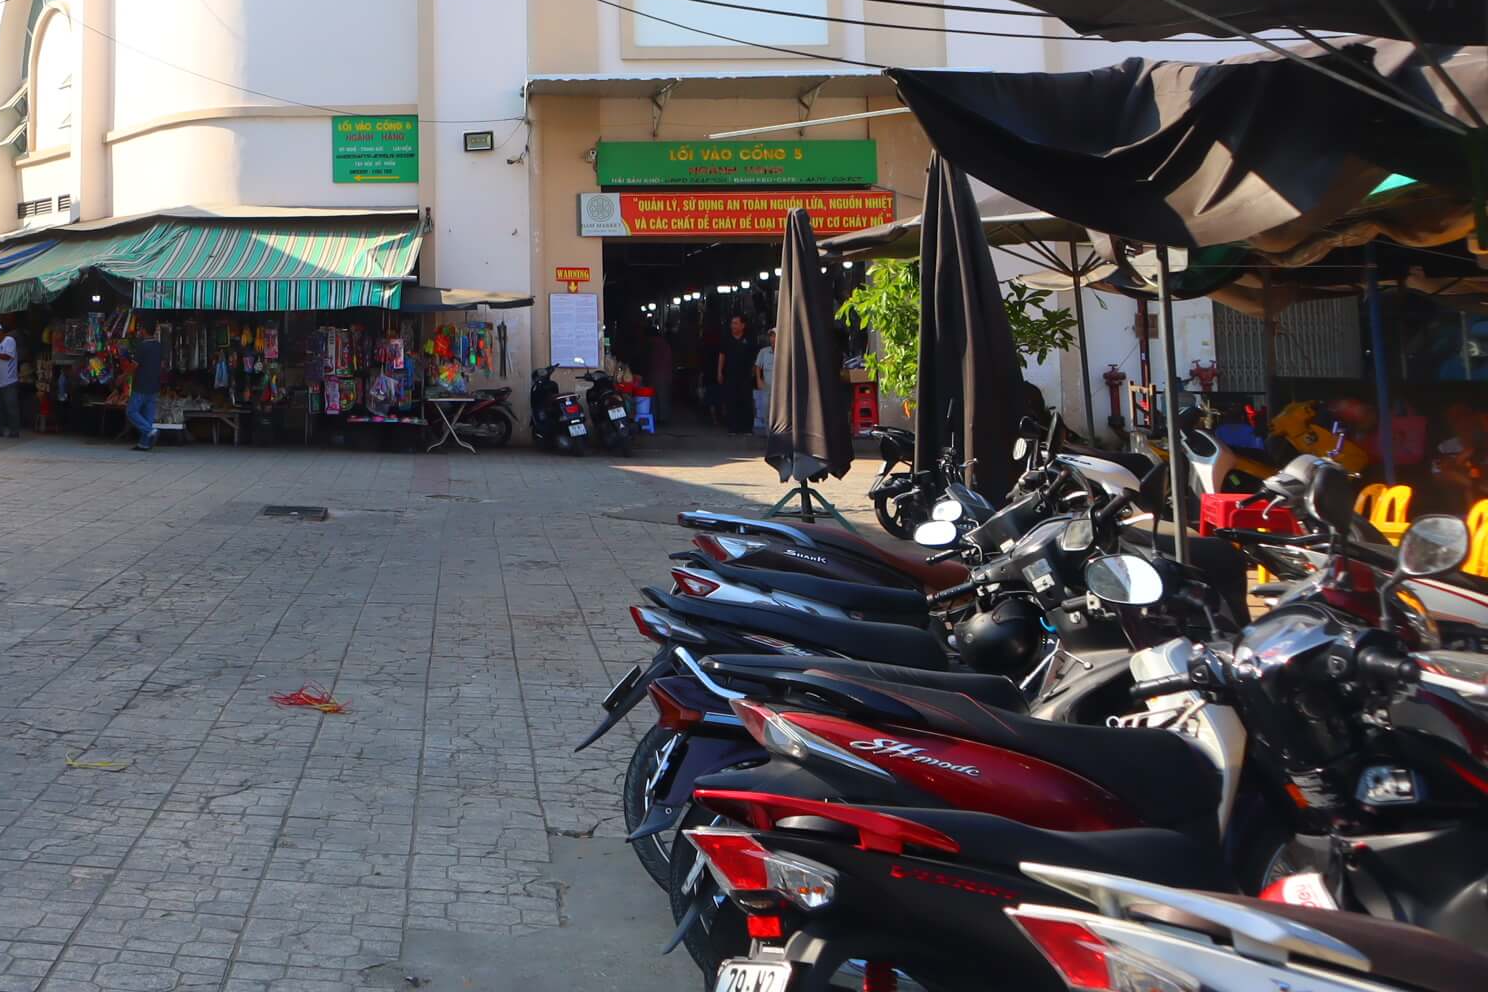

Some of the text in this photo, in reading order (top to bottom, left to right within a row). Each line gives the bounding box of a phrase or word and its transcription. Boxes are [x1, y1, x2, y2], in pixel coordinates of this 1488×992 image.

[669, 144, 694, 160] LỐI
[701, 145, 732, 160] VÀO
[740, 143, 786, 160] CỔNG
[727, 200, 740, 211] AN
[742, 198, 768, 210] TOÀN
[635, 216, 647, 230] VÀ
[649, 216, 669, 230] CÁC
[556, 269, 589, 280] WARNING
